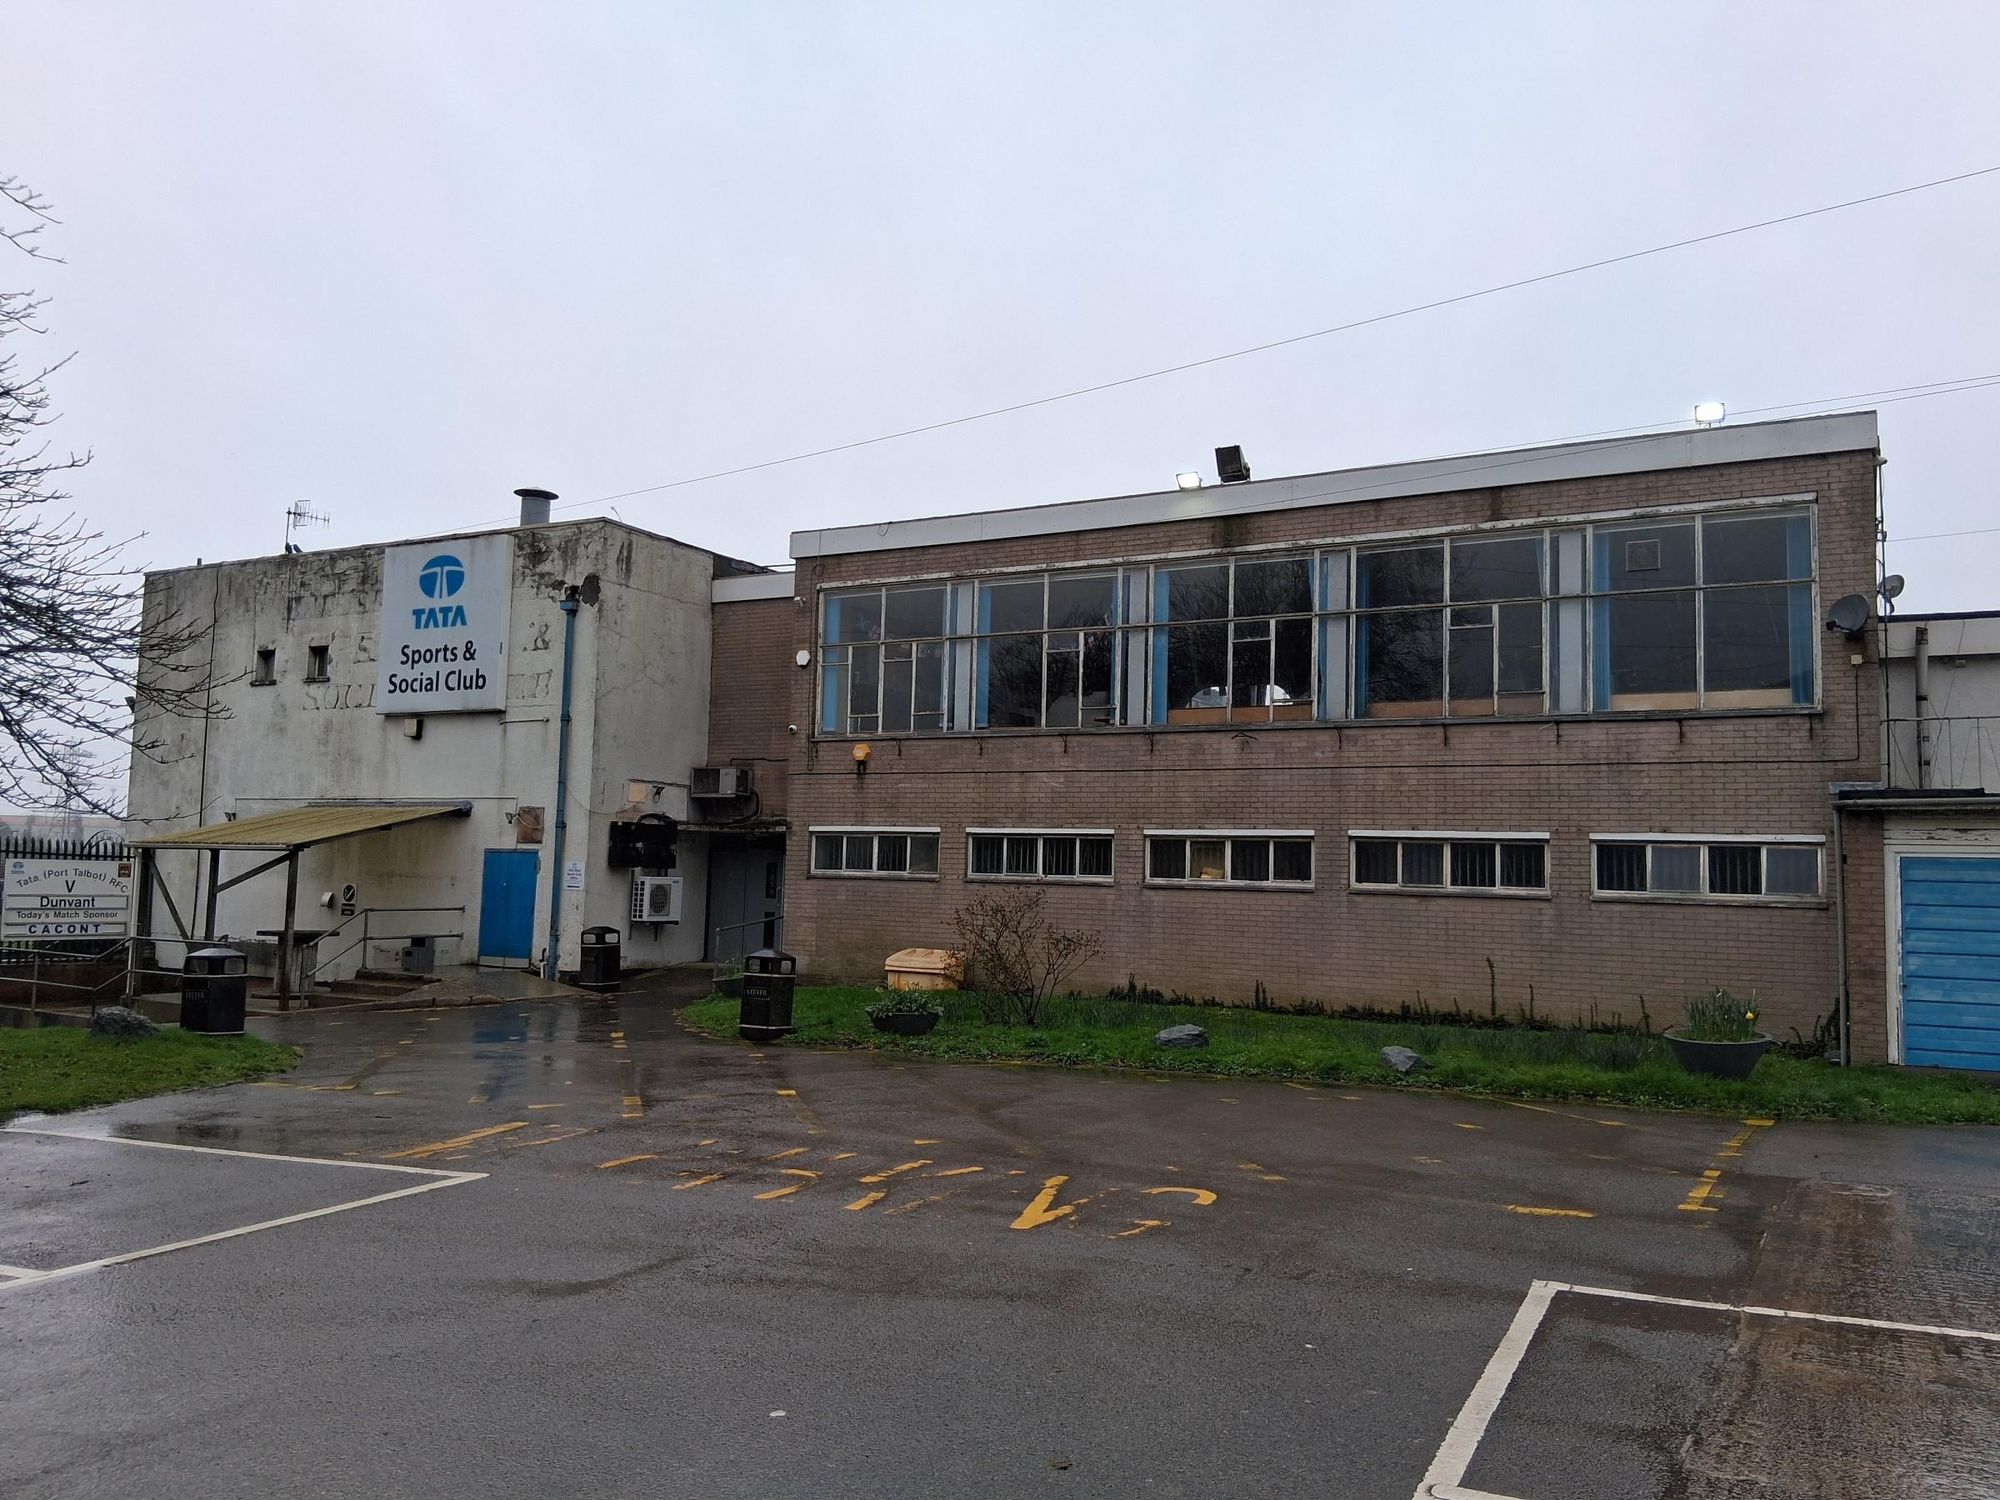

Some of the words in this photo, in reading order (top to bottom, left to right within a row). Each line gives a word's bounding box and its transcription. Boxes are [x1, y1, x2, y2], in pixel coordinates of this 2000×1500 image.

[412, 605, 468, 630] TATA
[400, 643, 459, 670] Sports
[462, 640, 477, 662] &
[388, 670, 440, 694] Social
[444, 668, 487, 692] Club
[16, 874, 40, 888] Tata
[43, 868, 68, 880] (Port
[73, 868, 107, 882] Talbot)
[109, 877, 129, 893] RFC
[65, 880, 76, 893] V
[40, 896, 96, 908] Dunvant
[16, 911, 50, 919] Today's
[53, 911, 80, 919] Match
[83, 911, 118, 919] Sponsor
[28, 924, 101, 934] CACONT
